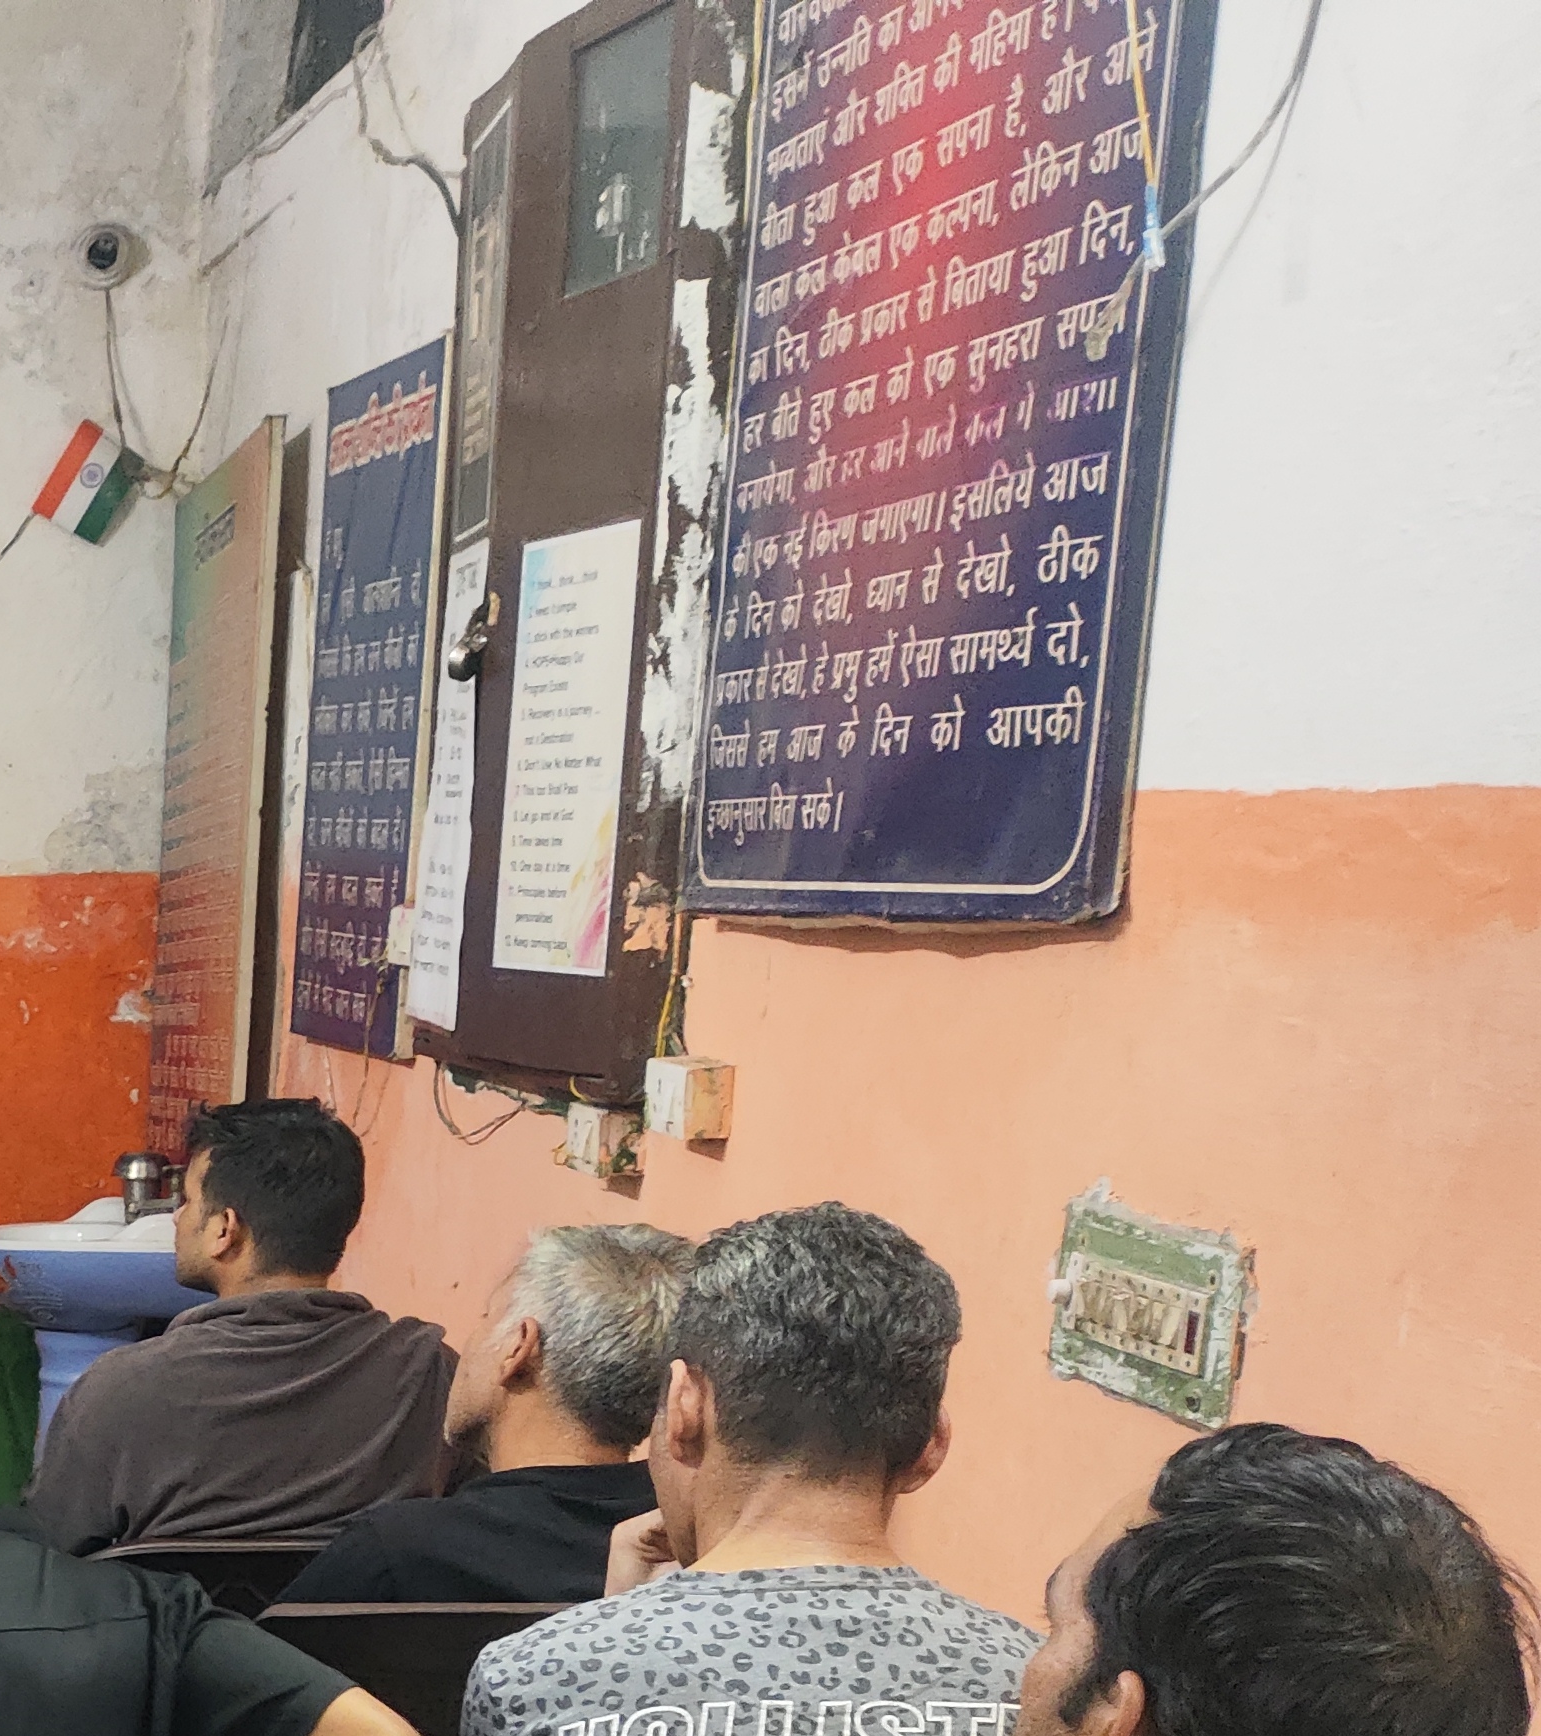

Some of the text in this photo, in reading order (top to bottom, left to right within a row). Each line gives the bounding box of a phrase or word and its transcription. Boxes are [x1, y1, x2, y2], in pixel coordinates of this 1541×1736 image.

[761, 202, 798, 250] बीता
[803, 181, 840, 246] हुआ
[846, 159, 884, 211] कल
[892, 138, 927, 196] एक
[936, 104, 995, 168] सपना
[1005, 73, 1027, 138] है,
[1042, 46, 1095, 114] और
[754, 113, 1150, 319] वाला कल केवल एक कल्पना, लेकिन आज
[748, 199, 1134, 385] का दिन, ठीक प्रकार से बिताया हुआ दिन,
[950, 451, 1036, 532] इसलिये
[1043, 451, 1111, 502] आज
[724, 525, 1105, 642] के दिन को देखो, ध्यान से देखो, ठीक
[716, 602, 1090, 706] प्रकार से देखो, हे प्रभु हमें ऐसा सामर्थ्य दो,
[711, 685, 1087, 769] जिससे हम आज के दिन को आपकी
[769, 782, 798, 830] बिता
